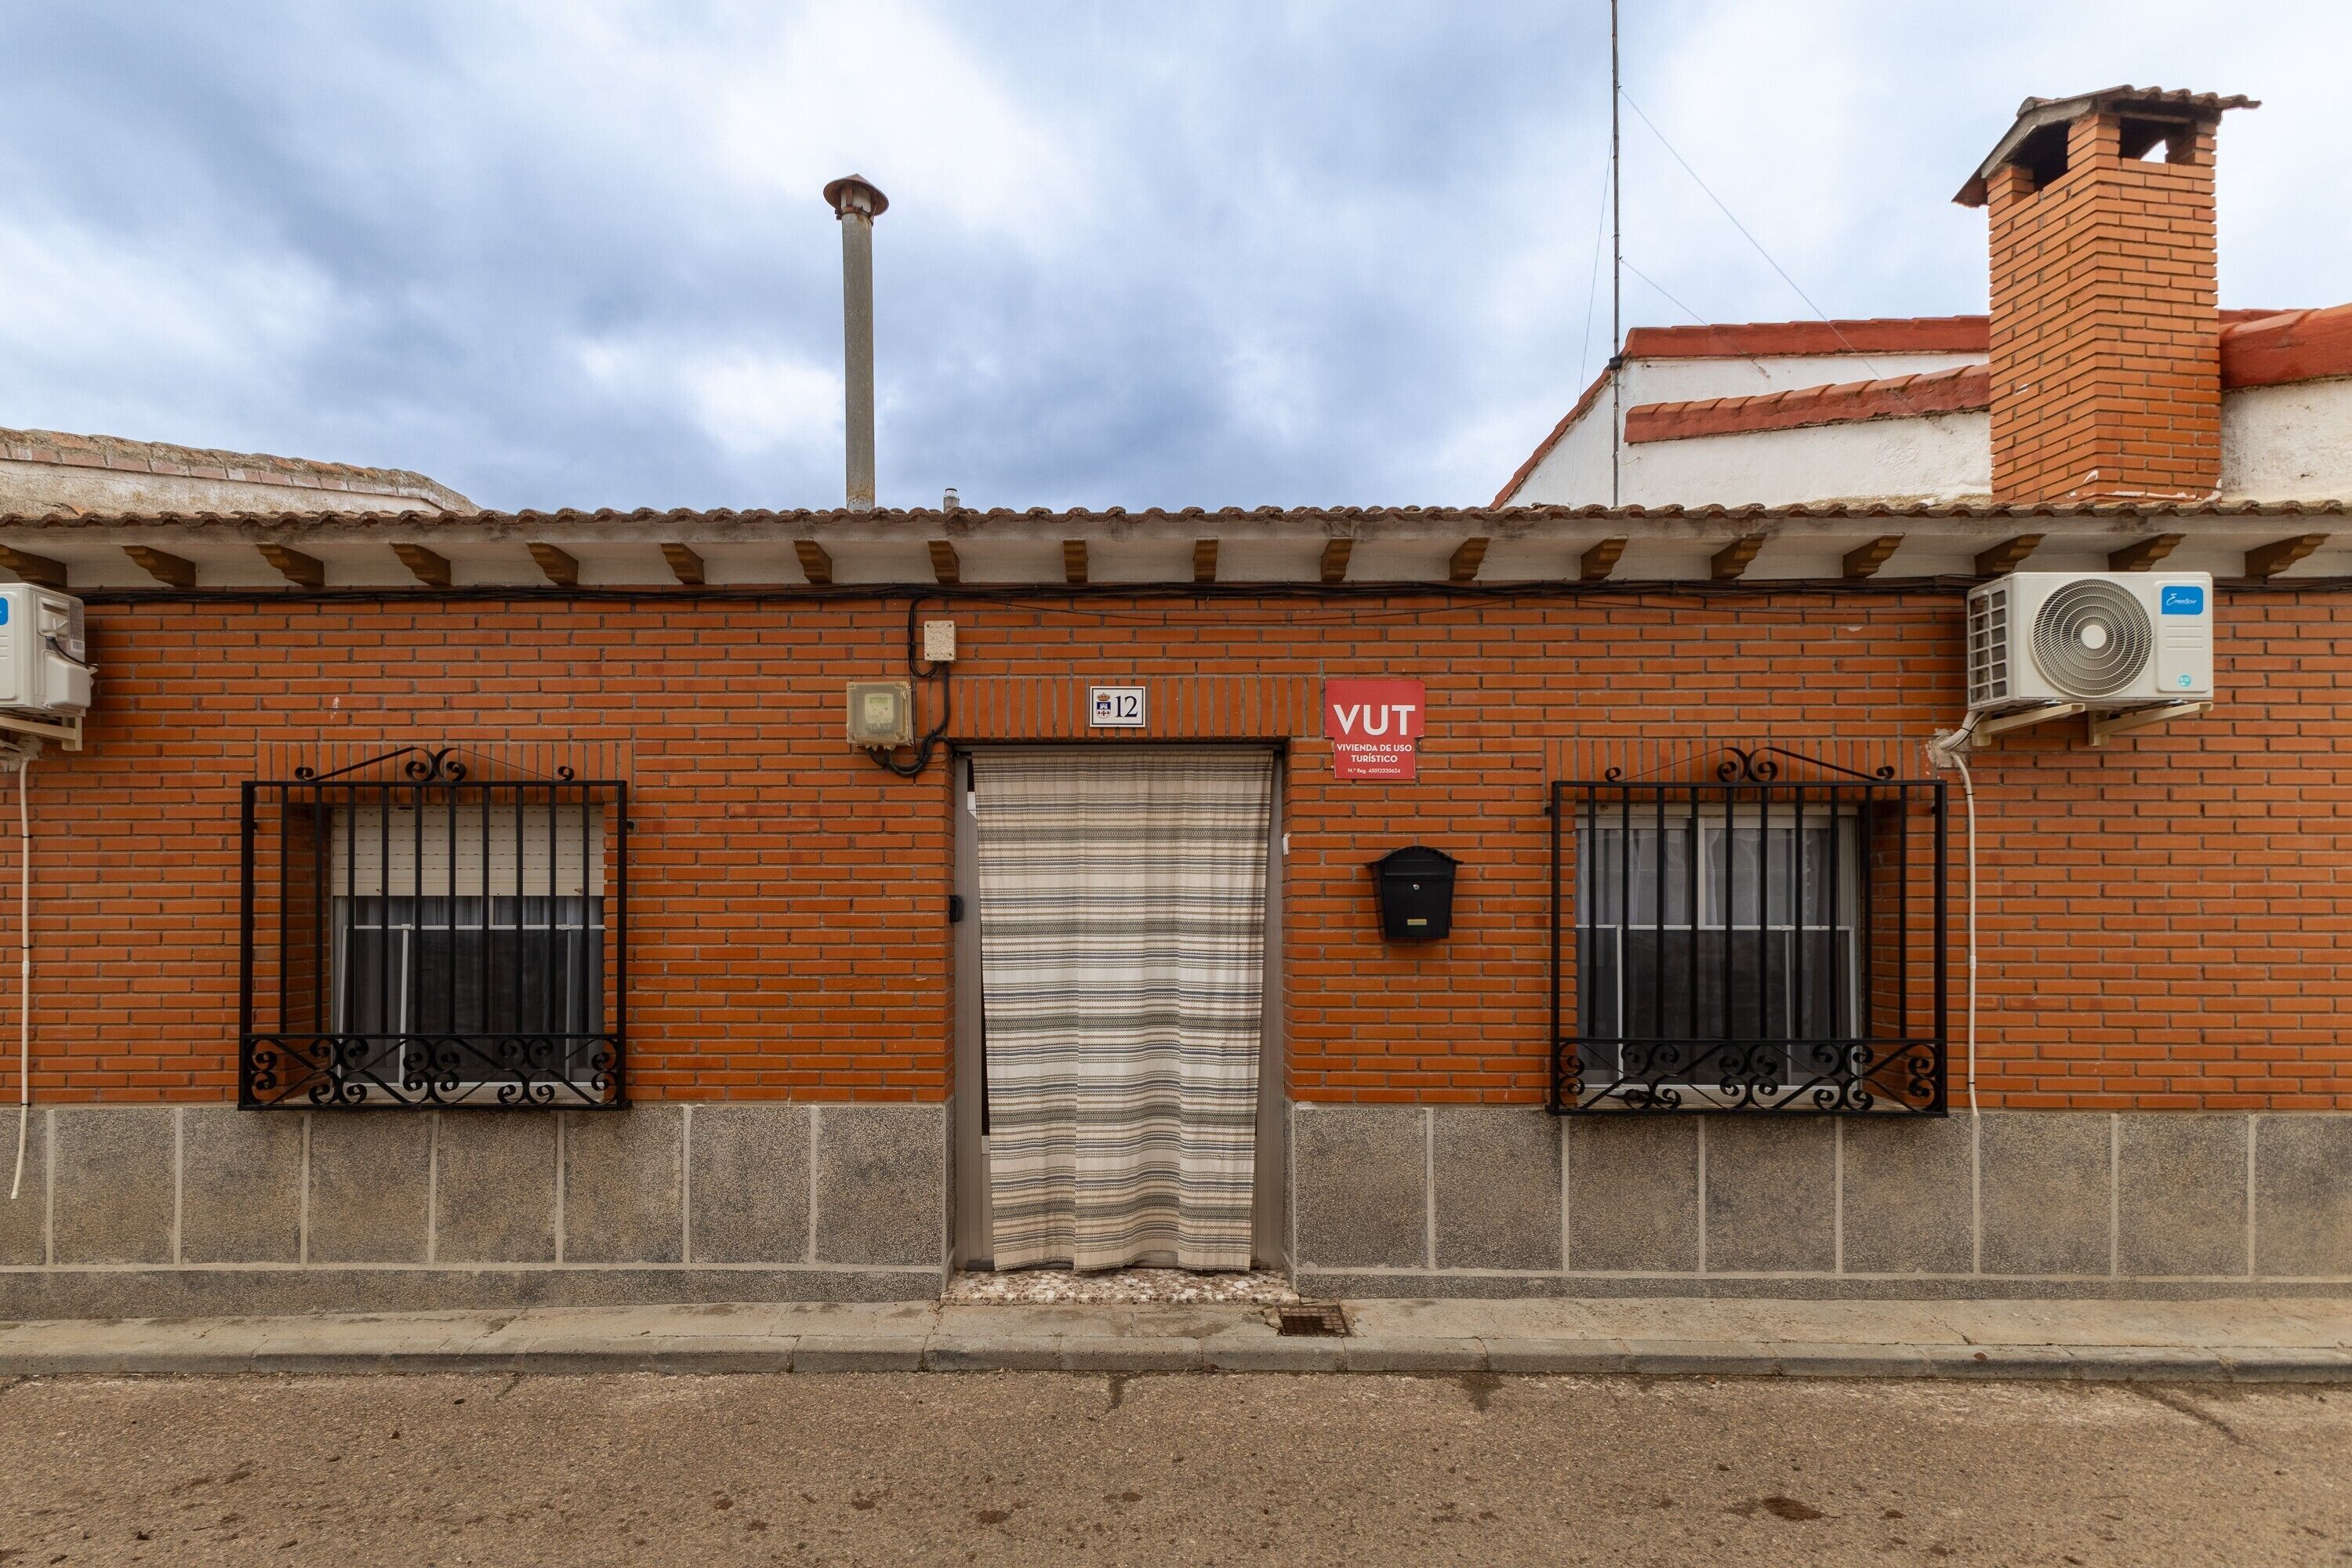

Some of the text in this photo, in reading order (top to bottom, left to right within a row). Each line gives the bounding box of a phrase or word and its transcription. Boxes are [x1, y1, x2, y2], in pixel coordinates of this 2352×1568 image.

[1114, 695, 1138, 717] 12
[1333, 704, 1416, 735] VUT
[1351, 753, 1398, 763] TURÍSTICO
